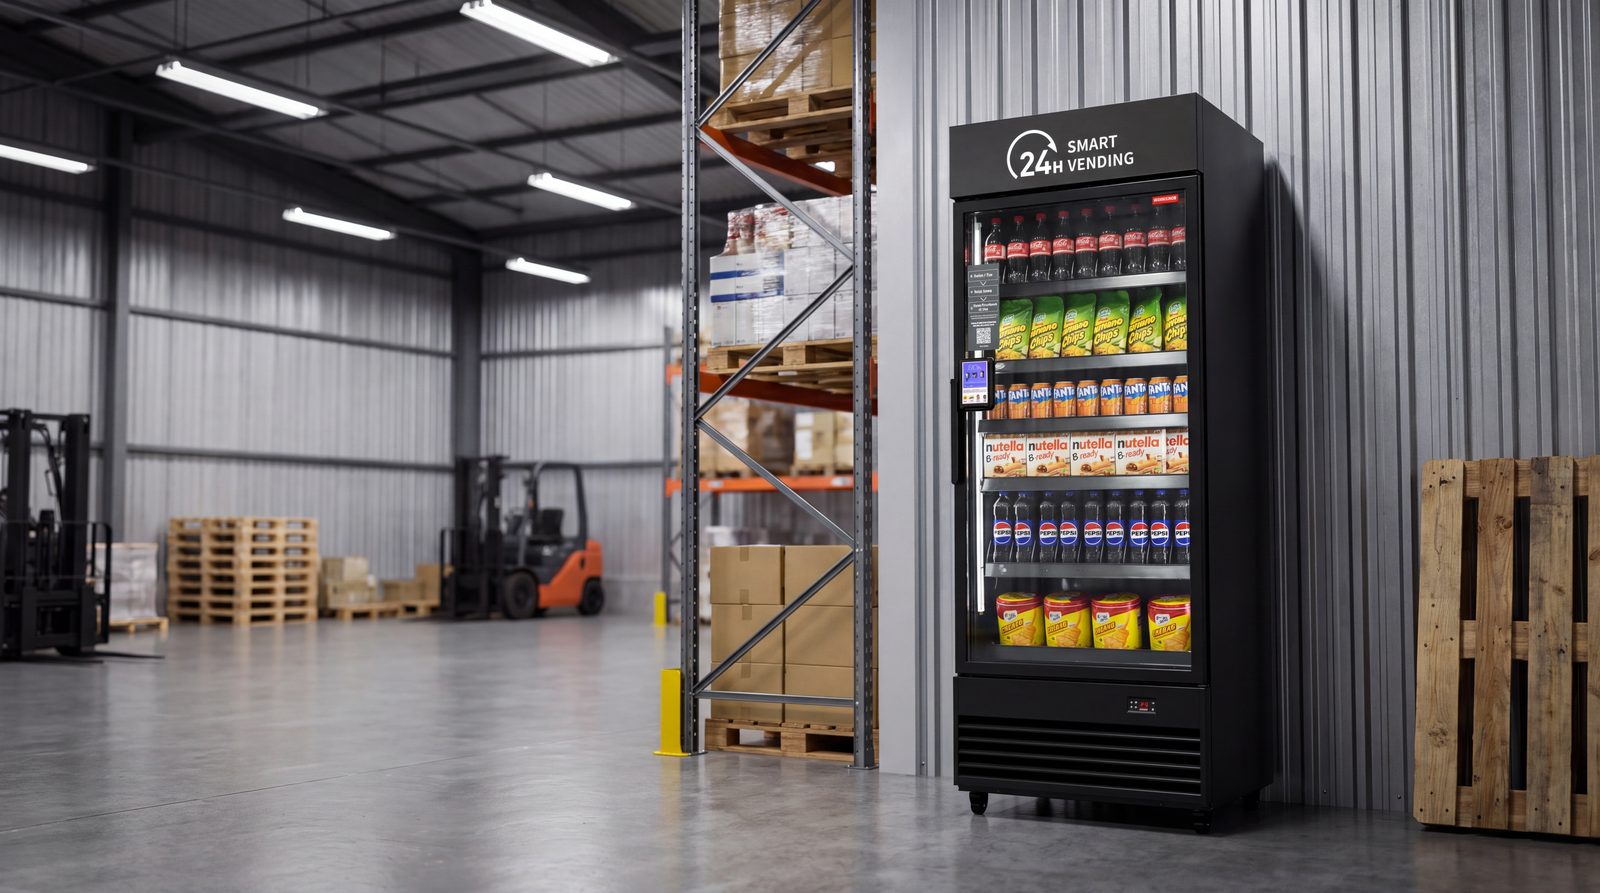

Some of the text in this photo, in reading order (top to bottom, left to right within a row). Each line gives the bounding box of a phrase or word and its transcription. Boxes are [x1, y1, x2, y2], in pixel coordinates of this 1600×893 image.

[1068, 135, 1118, 153] SMART
[1068, 152, 1134, 171] VENDING
[1166, 326, 1186, 342] Chip
[1173, 381, 1188, 394] FAN
[986, 440, 1024, 452] nutella
[1029, 439, 1068, 451] nutella
[1073, 437, 1112, 450] nutella
[1117, 436, 1159, 448] nutella
[1166, 434, 1189, 446] tella
